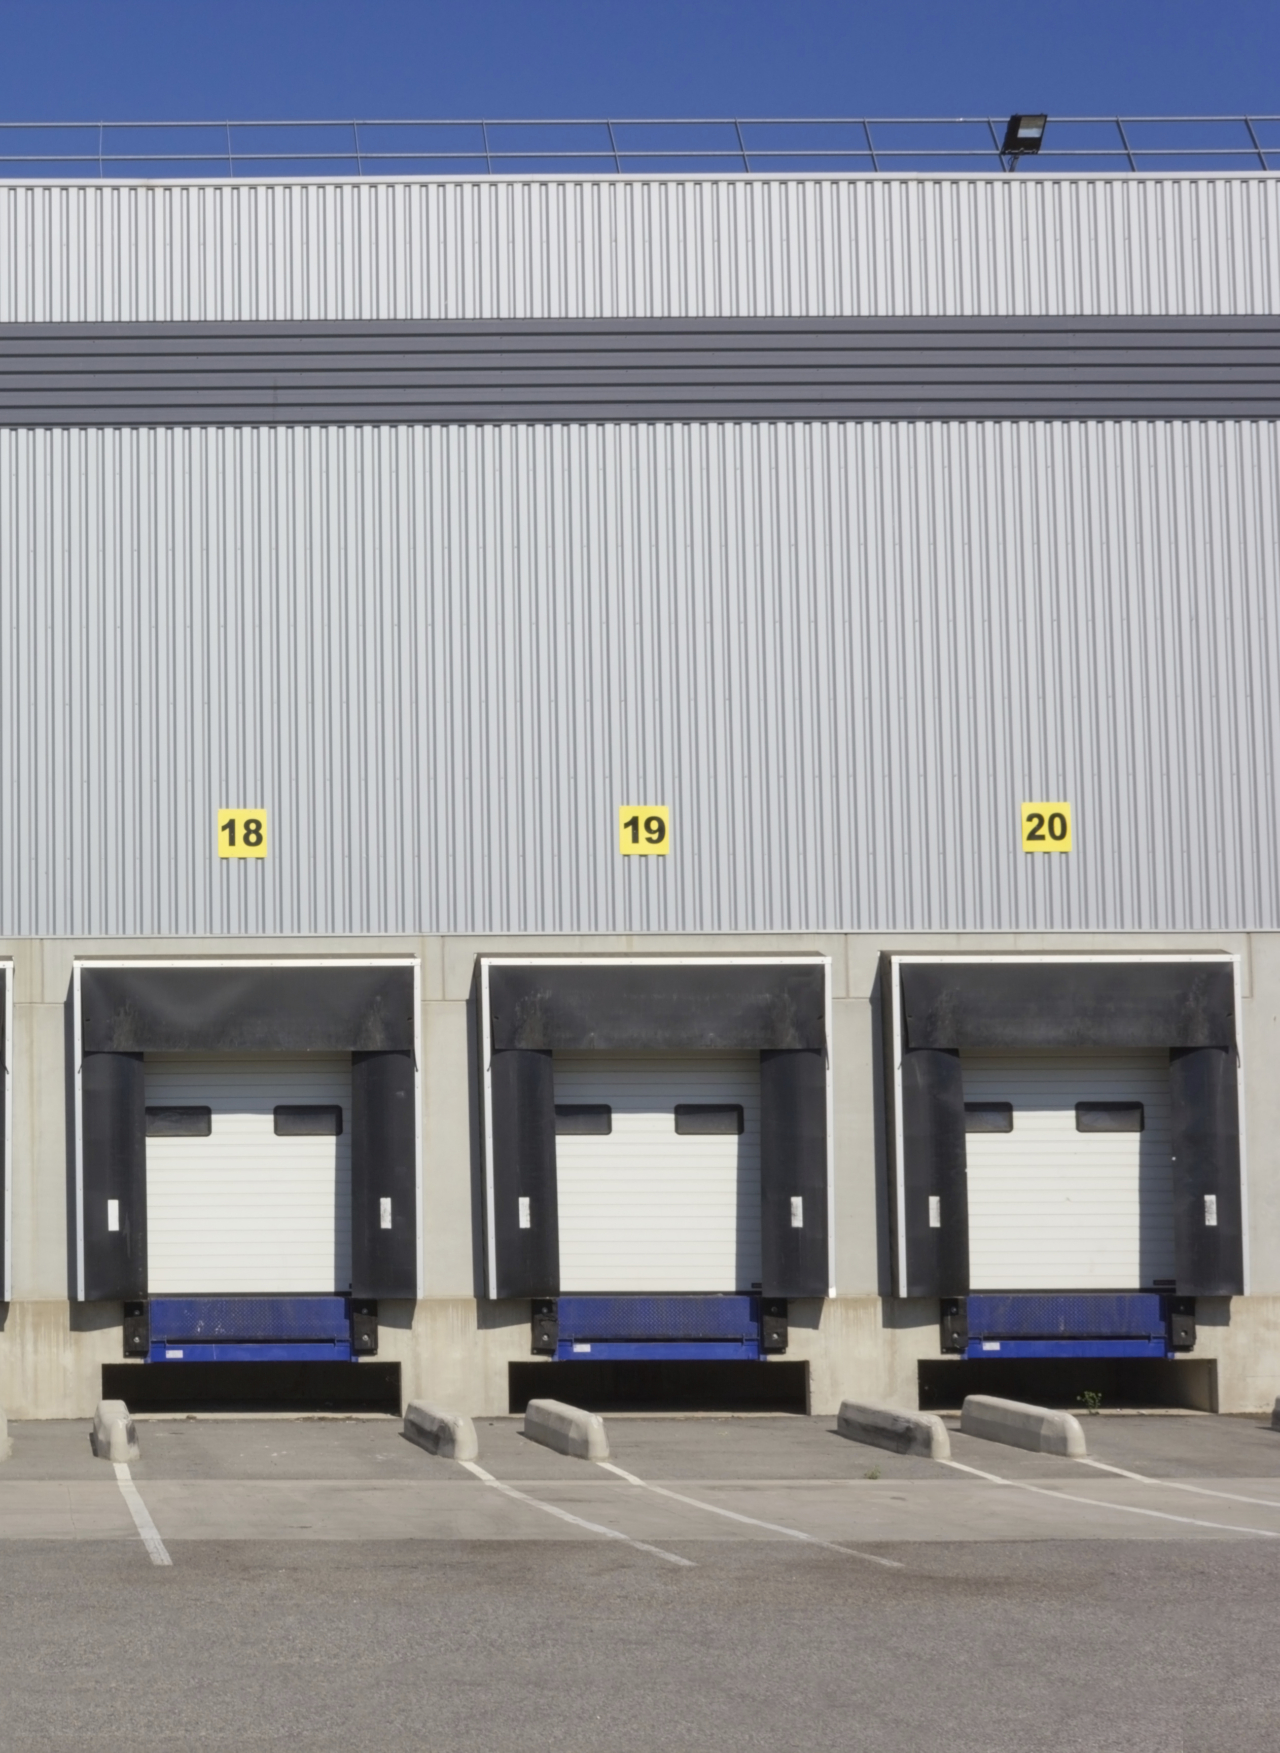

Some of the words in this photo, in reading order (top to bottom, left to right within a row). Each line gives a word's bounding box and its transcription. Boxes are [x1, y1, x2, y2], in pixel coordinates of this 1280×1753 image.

[221, 818, 263, 847] 18
[623, 816, 665, 844] 19
[1026, 812, 1067, 841] 20
